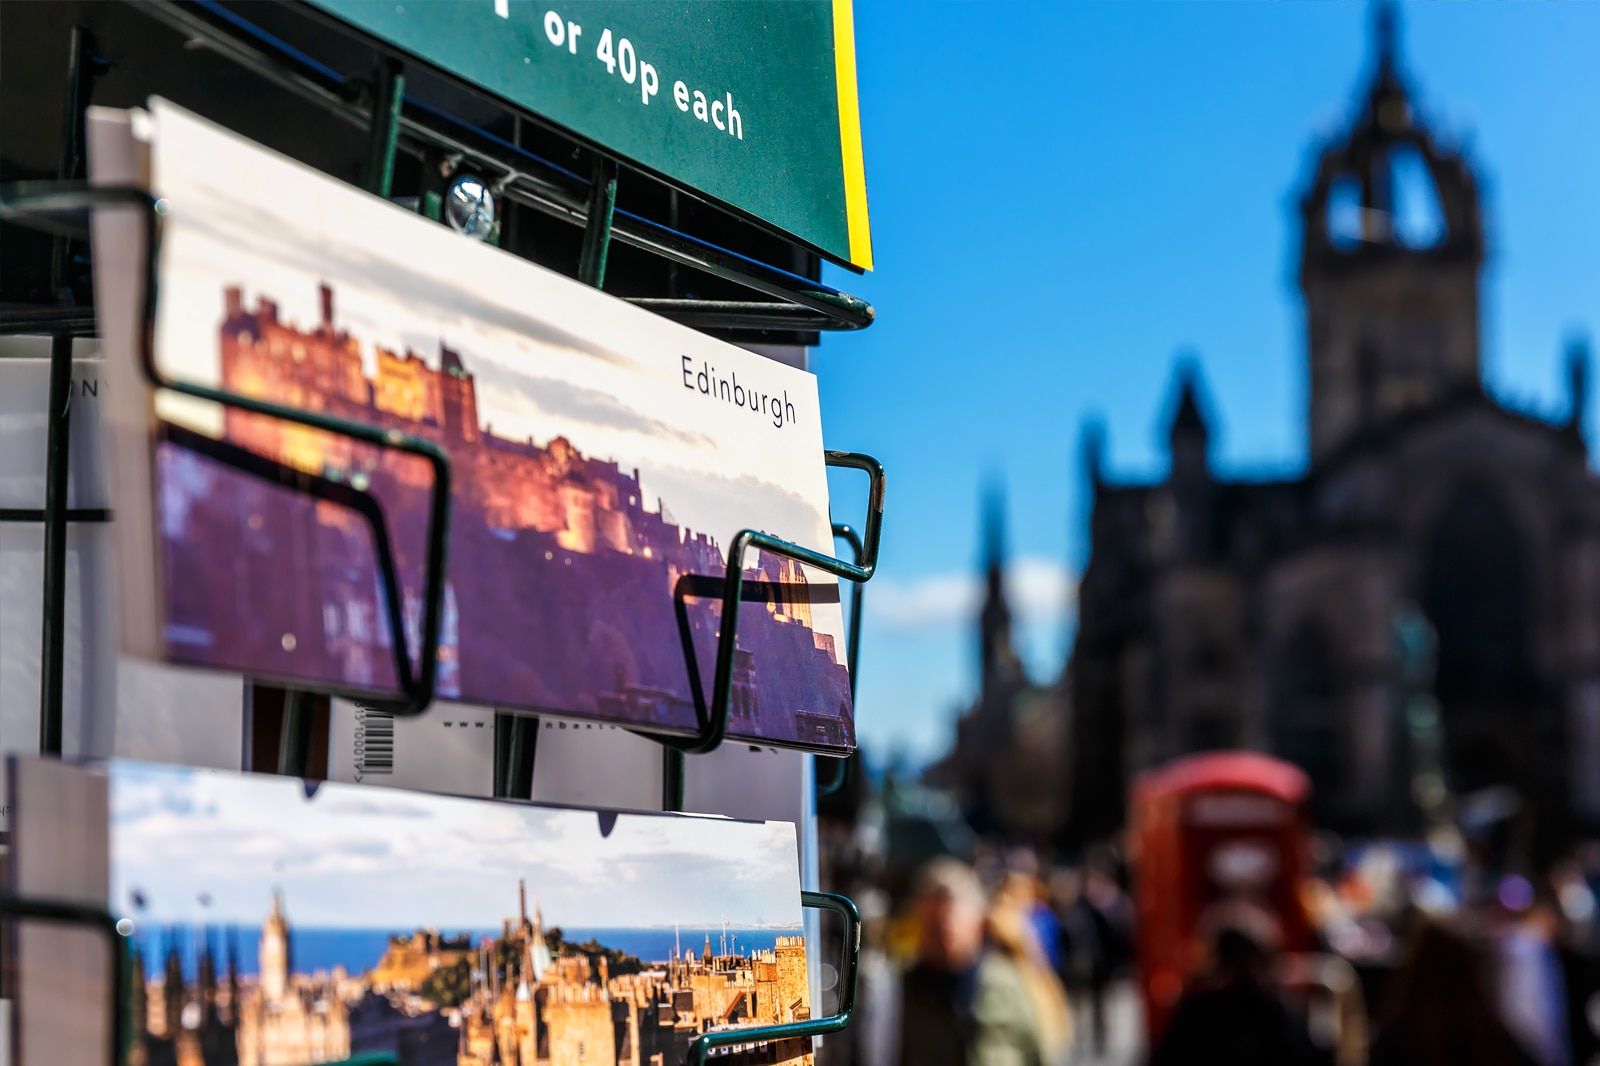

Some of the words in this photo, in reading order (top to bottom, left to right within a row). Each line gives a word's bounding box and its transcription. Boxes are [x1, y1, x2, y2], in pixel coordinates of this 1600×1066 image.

[543, 10, 582, 54] or
[596, 28, 659, 105] 40p
[673, 80, 743, 140] each
[681, 355, 796, 428] Edinburgh
